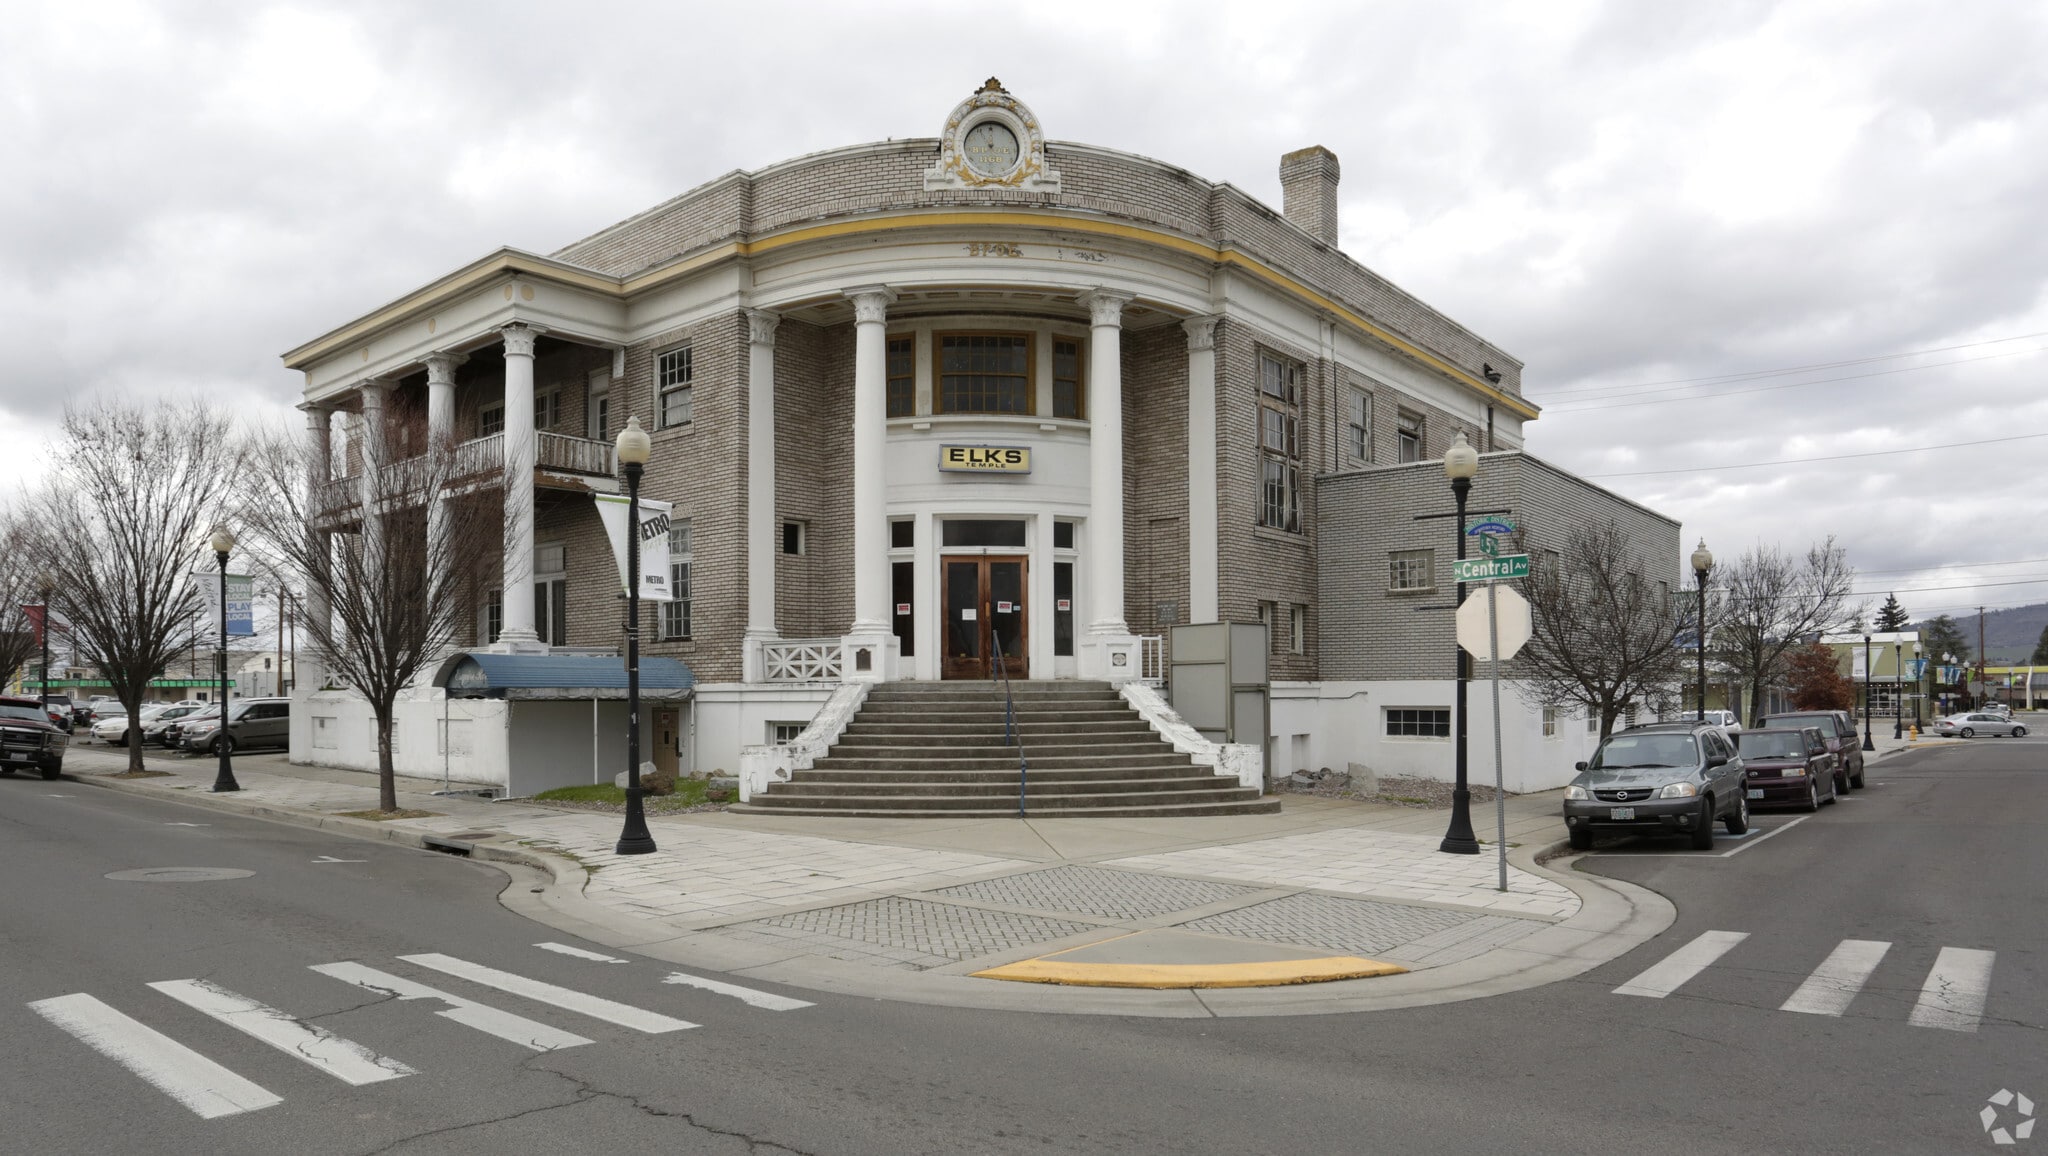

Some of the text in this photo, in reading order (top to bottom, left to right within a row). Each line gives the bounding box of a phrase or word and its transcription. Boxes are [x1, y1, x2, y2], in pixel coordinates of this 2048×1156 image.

[950, 448, 1022, 464] ELKS
[1454, 559, 1527, 577] N Central Av
[645, 575, 665, 585] METRO
[227, 583, 252, 593] STAY
[227, 602, 252, 610] PLAY
[227, 613, 252, 621] LOCAL
